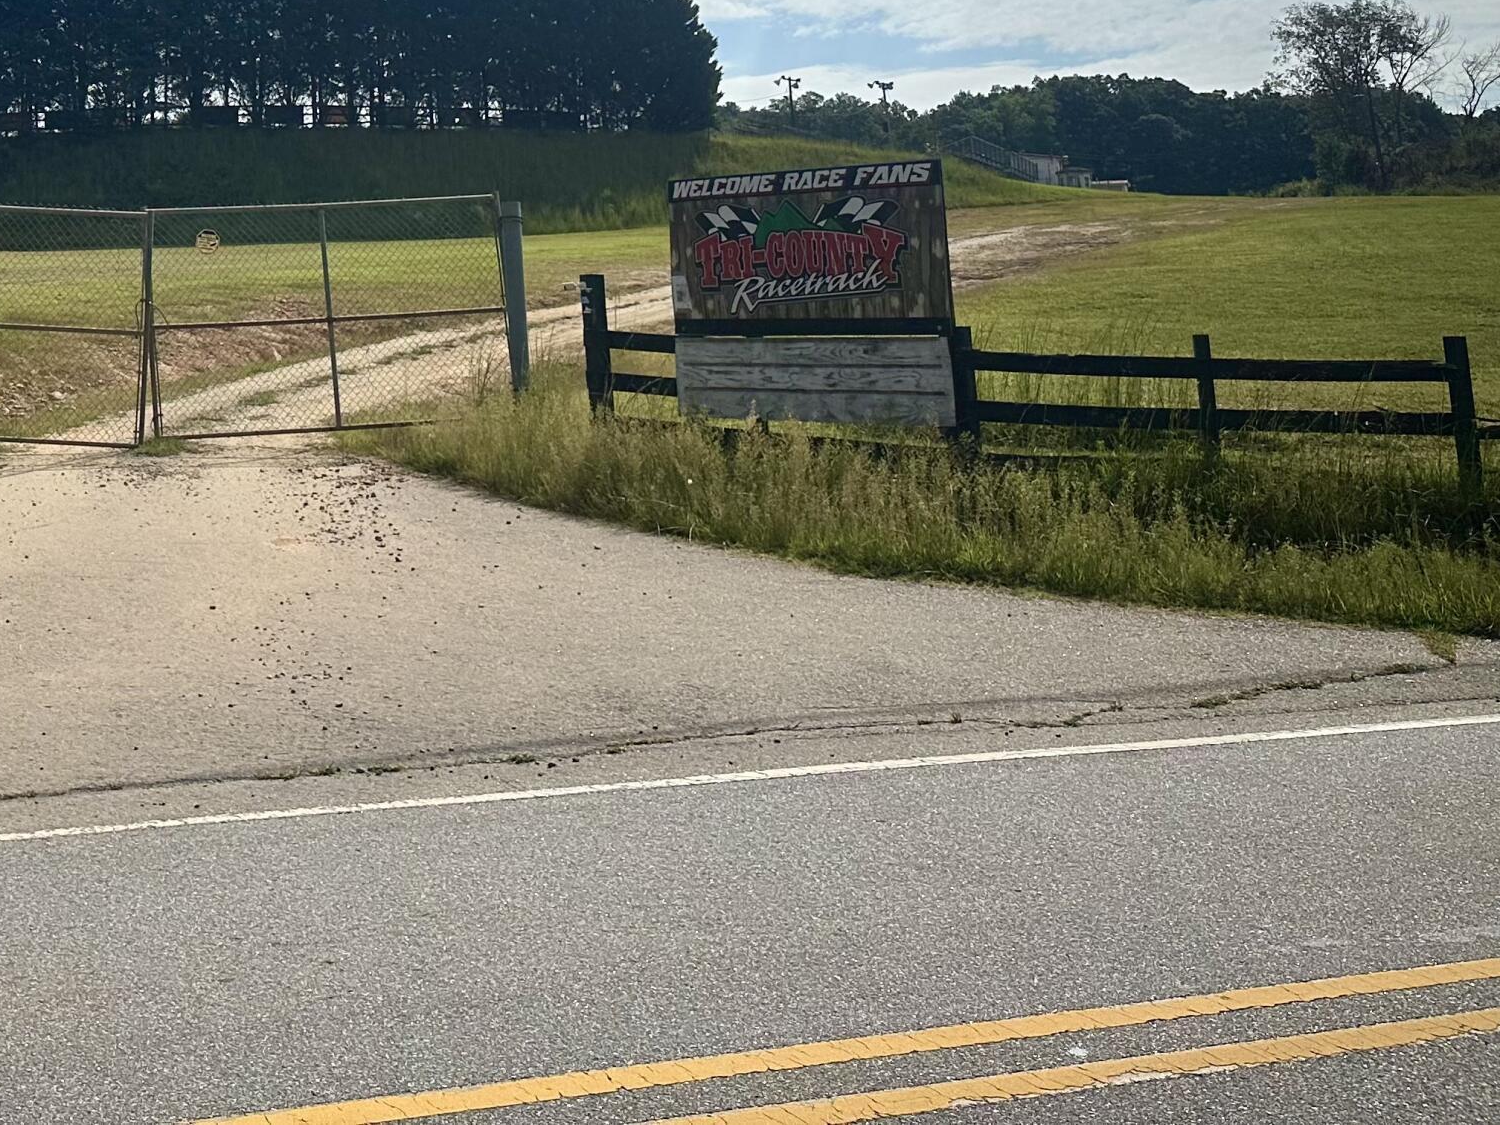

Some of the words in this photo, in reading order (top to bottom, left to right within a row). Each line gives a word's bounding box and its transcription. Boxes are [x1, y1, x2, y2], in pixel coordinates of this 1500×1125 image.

[673, 176, 774, 199] WELCOME
[782, 168, 847, 192] RACE
[853, 162, 932, 186] FANS
[695, 224, 905, 288] TRI-COUNTY
[730, 259, 889, 315] Racetrack
